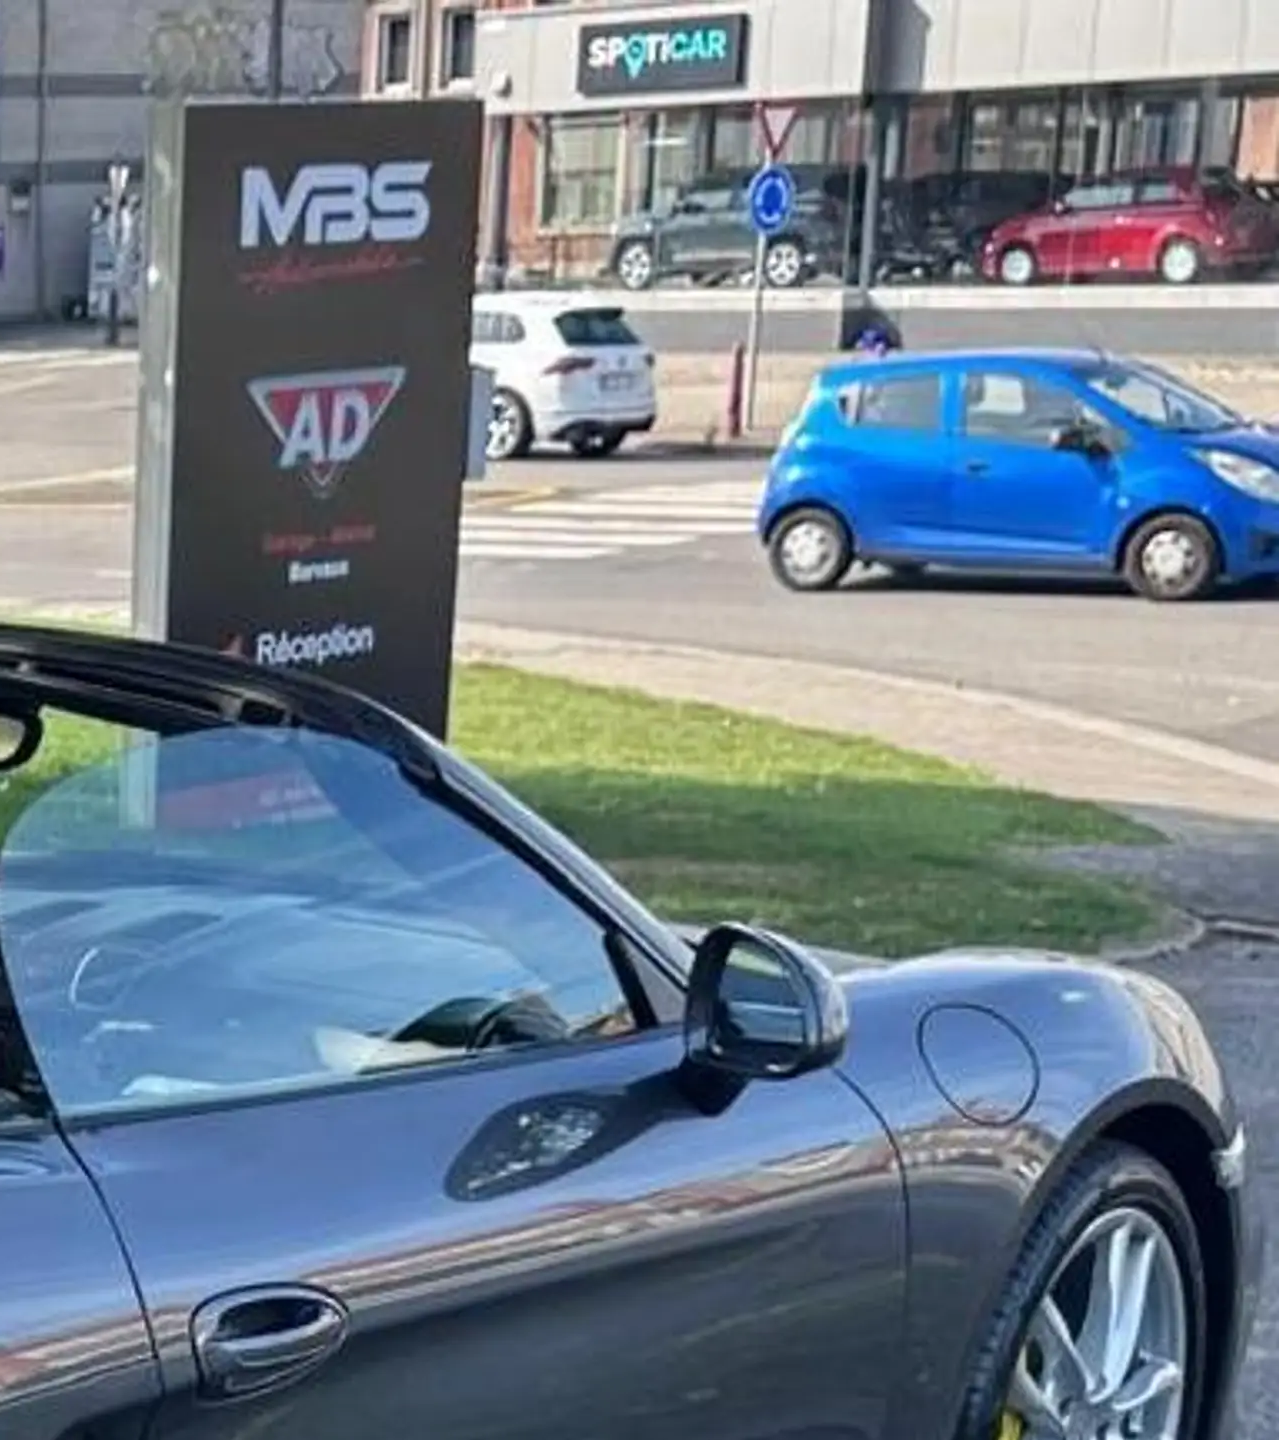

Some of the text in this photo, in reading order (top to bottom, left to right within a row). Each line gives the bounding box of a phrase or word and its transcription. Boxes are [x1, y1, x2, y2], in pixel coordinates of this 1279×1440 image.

[587, 28, 728, 80] SPOTICAR
[240, 160, 433, 248] MBS
[280, 389, 371, 469] AD
[256, 624, 374, 666] Réception
